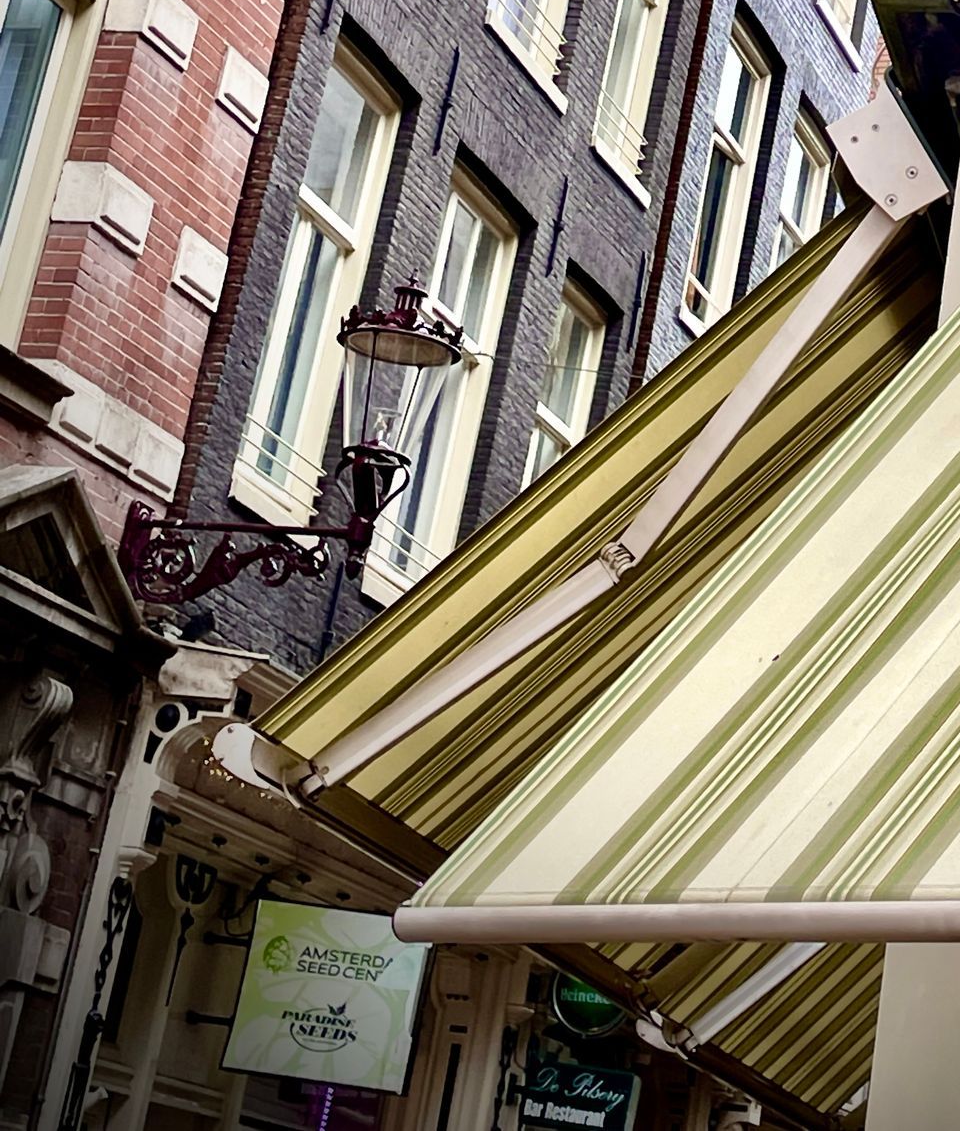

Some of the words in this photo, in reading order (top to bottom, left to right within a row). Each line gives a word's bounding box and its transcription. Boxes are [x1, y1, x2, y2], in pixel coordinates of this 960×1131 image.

[296, 960, 341, 977] SEED
[343, 966, 383, 982] CEN
[281, 1010, 356, 1028] PARADISE
[297, 1024, 358, 1042] SEEDS
[529, 1067, 560, 1092] De
[523, 1098, 544, 1118] Bar
[544, 1101, 606, 1129] Restaurant
